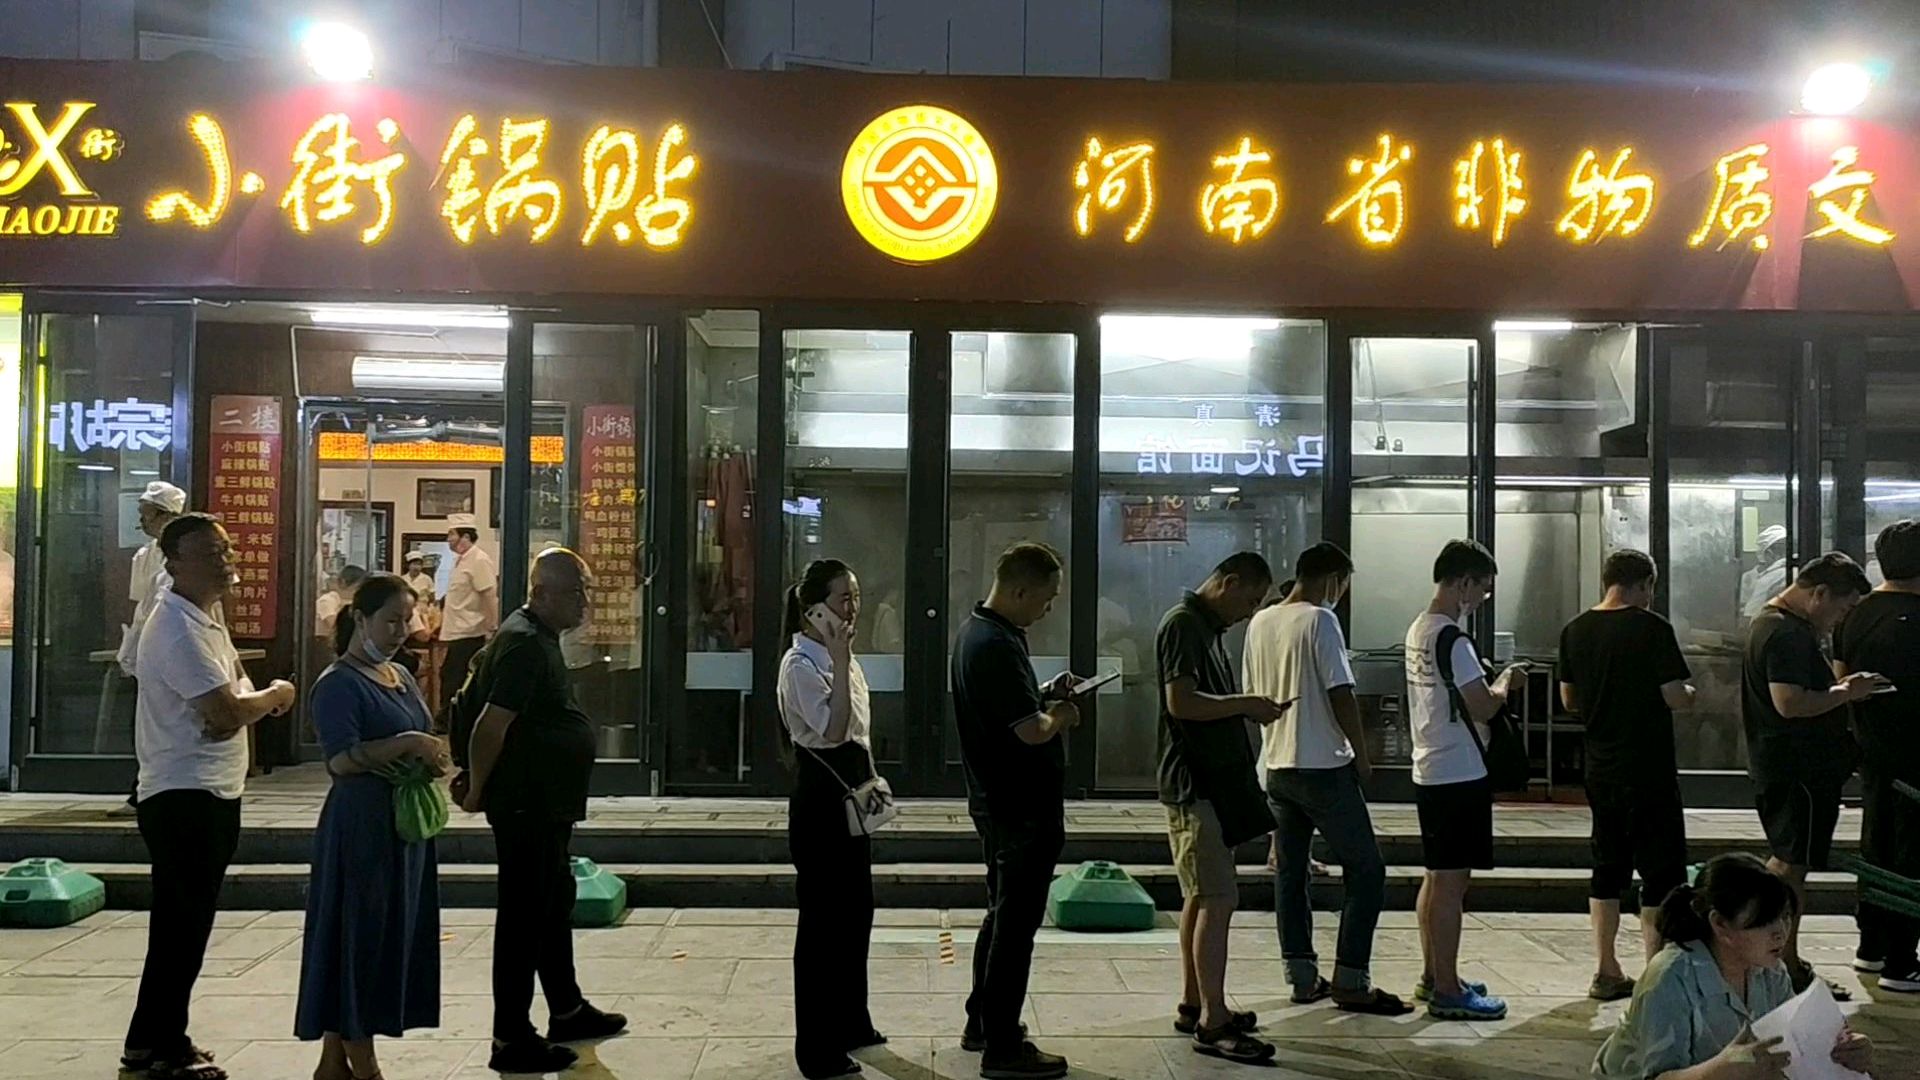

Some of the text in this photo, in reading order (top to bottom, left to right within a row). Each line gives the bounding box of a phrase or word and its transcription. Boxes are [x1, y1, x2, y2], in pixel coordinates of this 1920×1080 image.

[144, 112, 698, 246] 小街锅贴
[1074, 133, 1897, 252] 河南省非物质文
[219, 404, 278, 430] 二楼
[586, 414, 636, 438] 小街锅
[247, 532, 273, 546] 米饭
